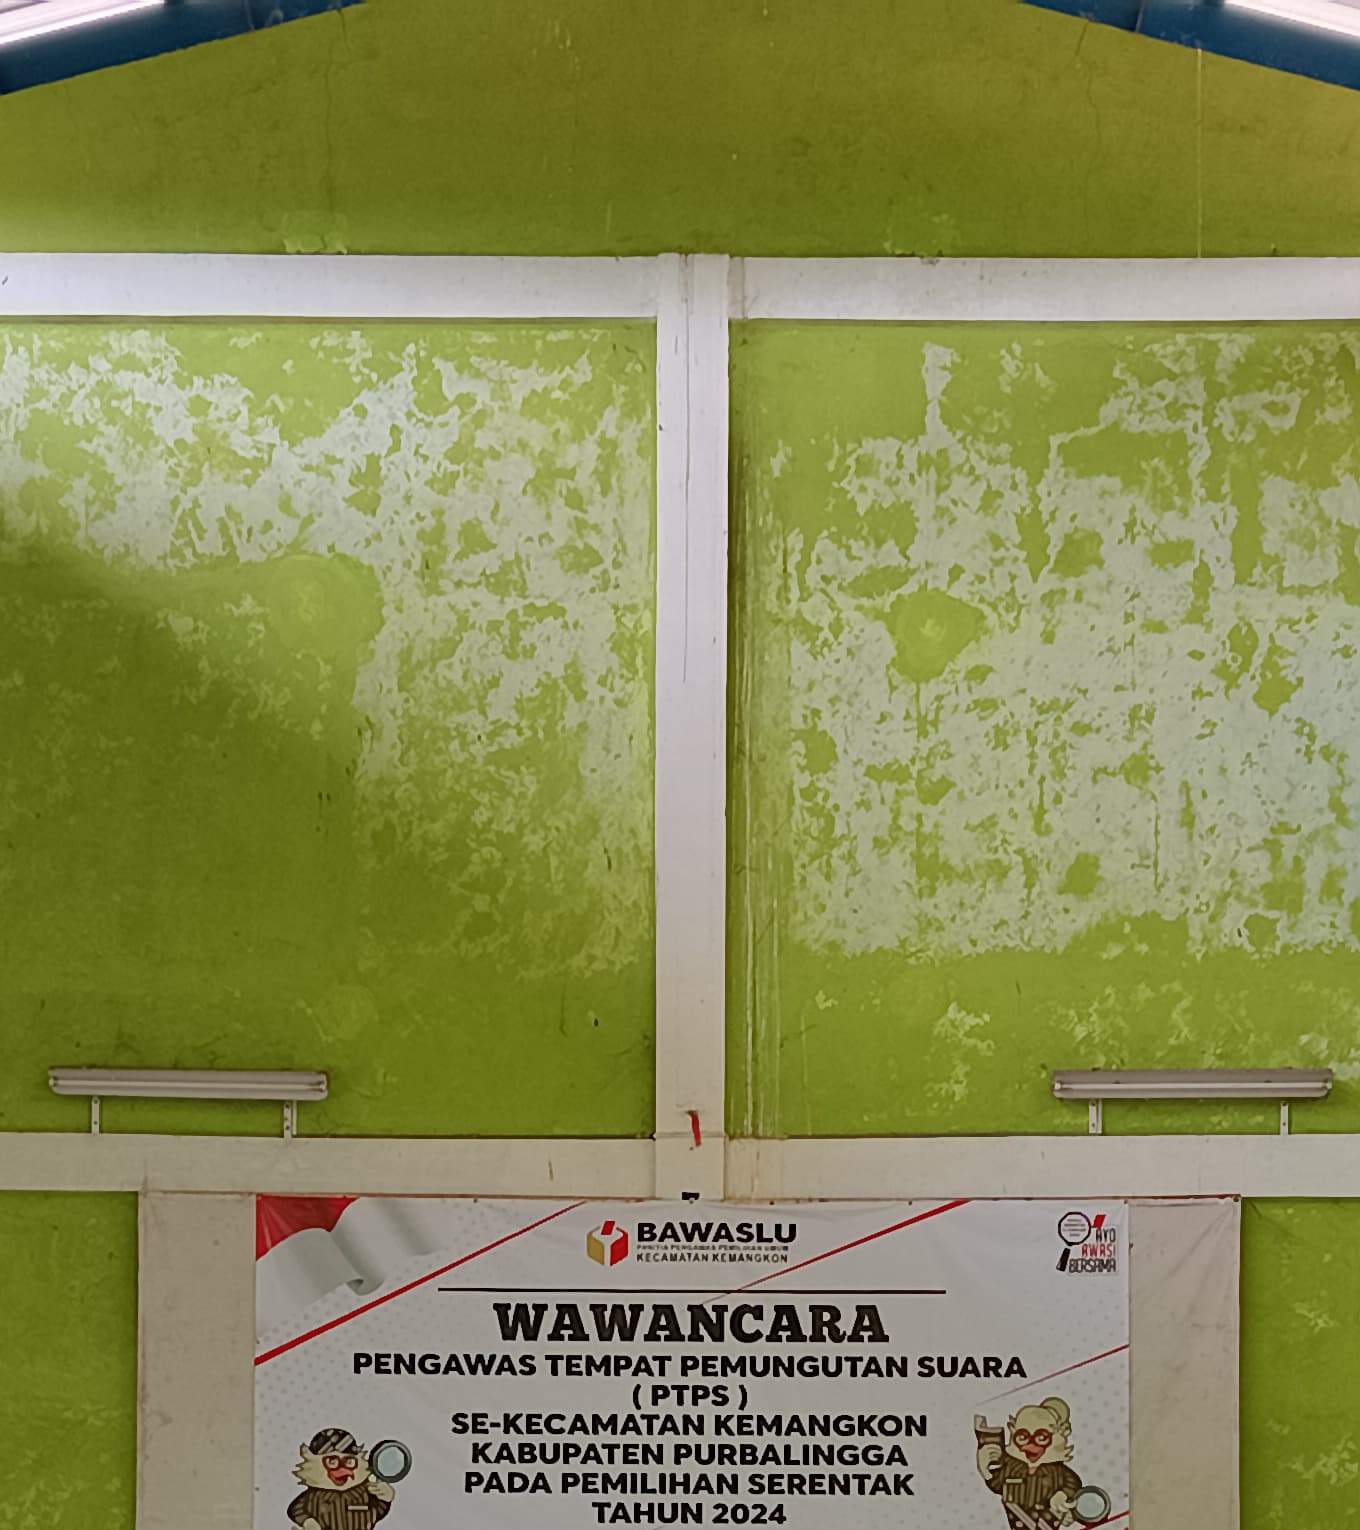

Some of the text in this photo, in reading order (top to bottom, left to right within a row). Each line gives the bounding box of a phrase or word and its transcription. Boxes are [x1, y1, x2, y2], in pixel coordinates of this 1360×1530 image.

[637, 1222, 797, 1243] BAWASLU
[1096, 1228, 1116, 1243] AYO
[636, 1253, 788, 1264] KECAMATAN KEMANGKON
[1082, 1244, 1116, 1257] AWASI
[1068, 1258, 1117, 1273] BERSAMA
[493, 1303, 889, 1343] WAWANCARA
[354, 1353, 1027, 1378] PENGAWAS TEMPAT PEMUNGUTAN SUARA
[452, 1413, 927, 1437] SE-KECAMATAN KEMANGKON
[472, 1442, 908, 1466] KABUPATEN PURBALINGGA
[465, 1472, 914, 1495] PADA PEMILIHAN SERENTAK
[592, 1502, 787, 1524] TAHUN 2024
